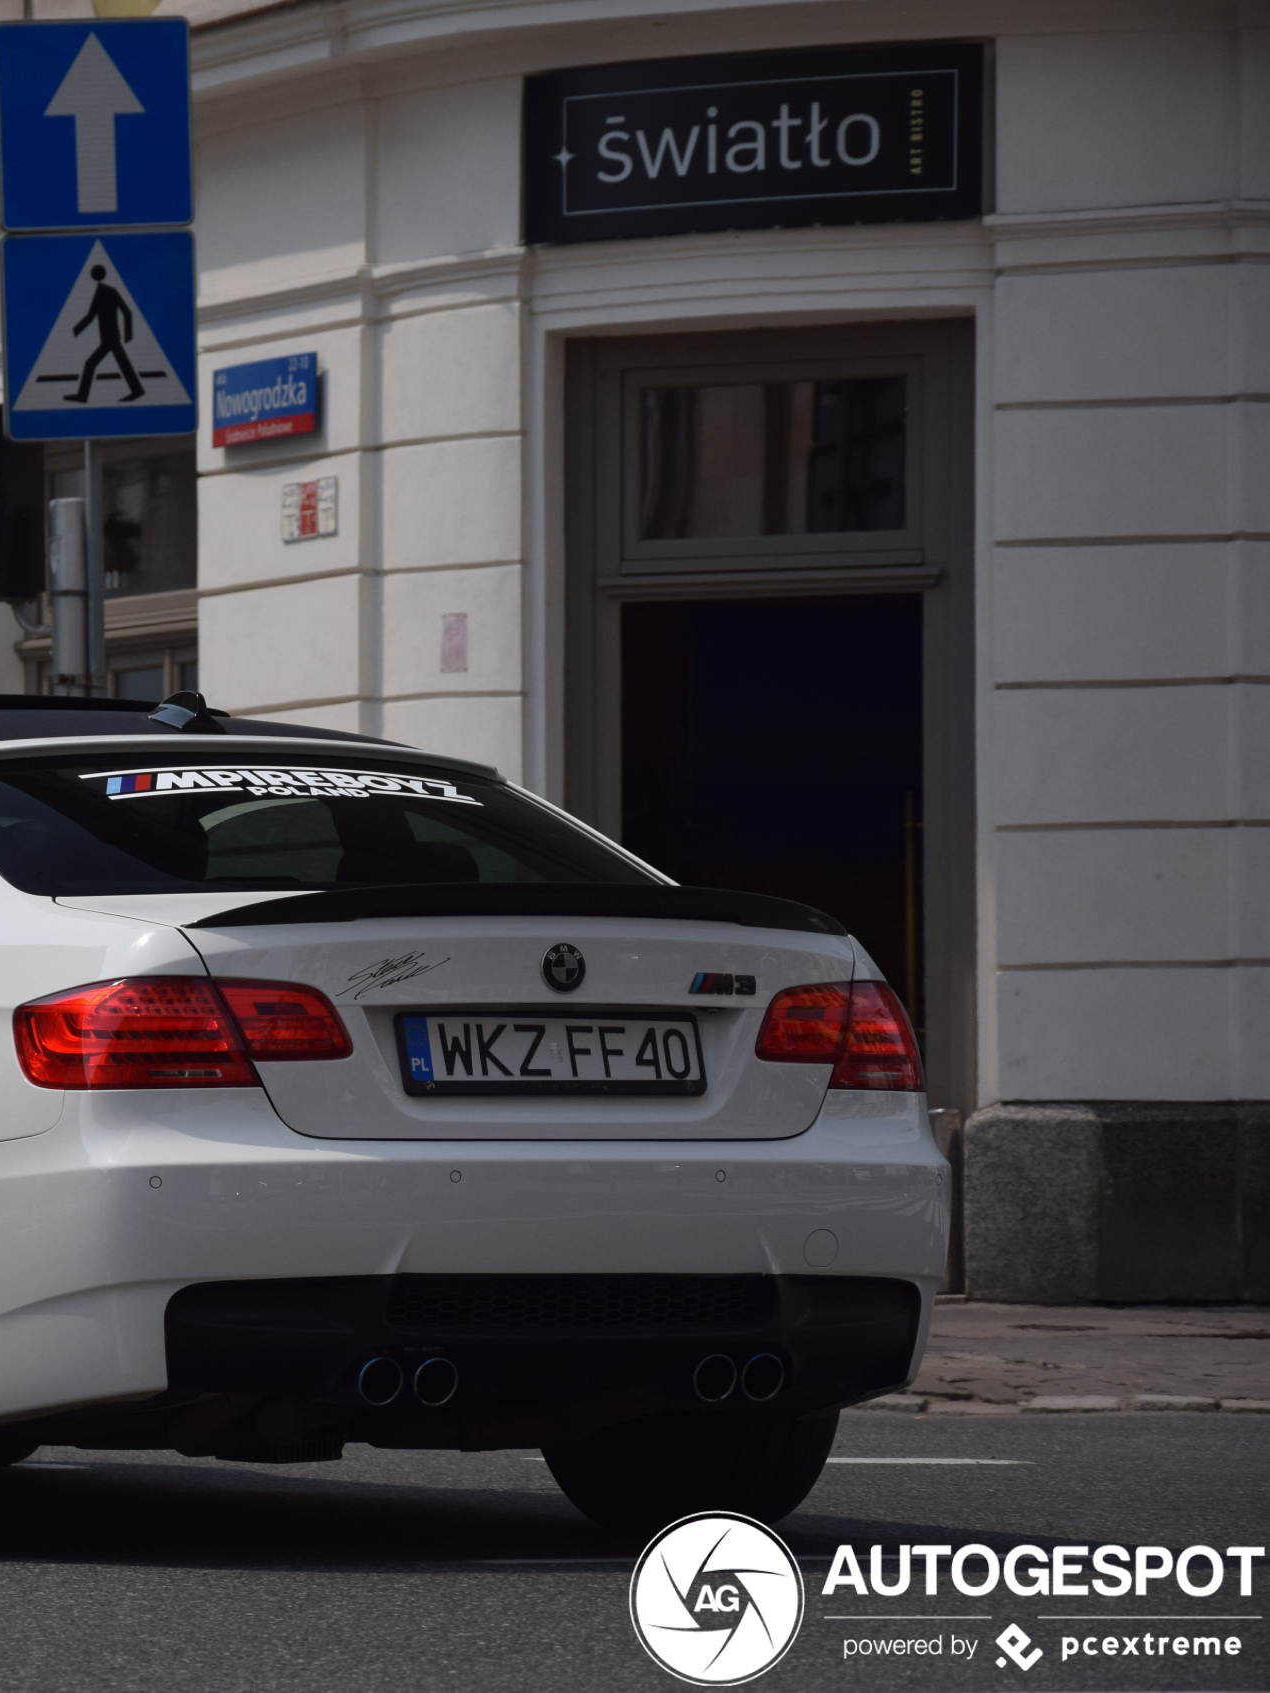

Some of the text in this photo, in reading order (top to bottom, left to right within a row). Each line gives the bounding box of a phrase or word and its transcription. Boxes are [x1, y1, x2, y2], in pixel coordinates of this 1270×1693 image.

[909, 89, 924, 175] ART BISTRO
[216, 374, 307, 420] Nowogrodzka
[245, 785, 370, 798] POLAND
[546, 945, 582, 961] BMW
[709, 973, 757, 996] M3
[437, 1023, 691, 1080] WKZ FF40
[411, 1057, 430, 1072] PL
